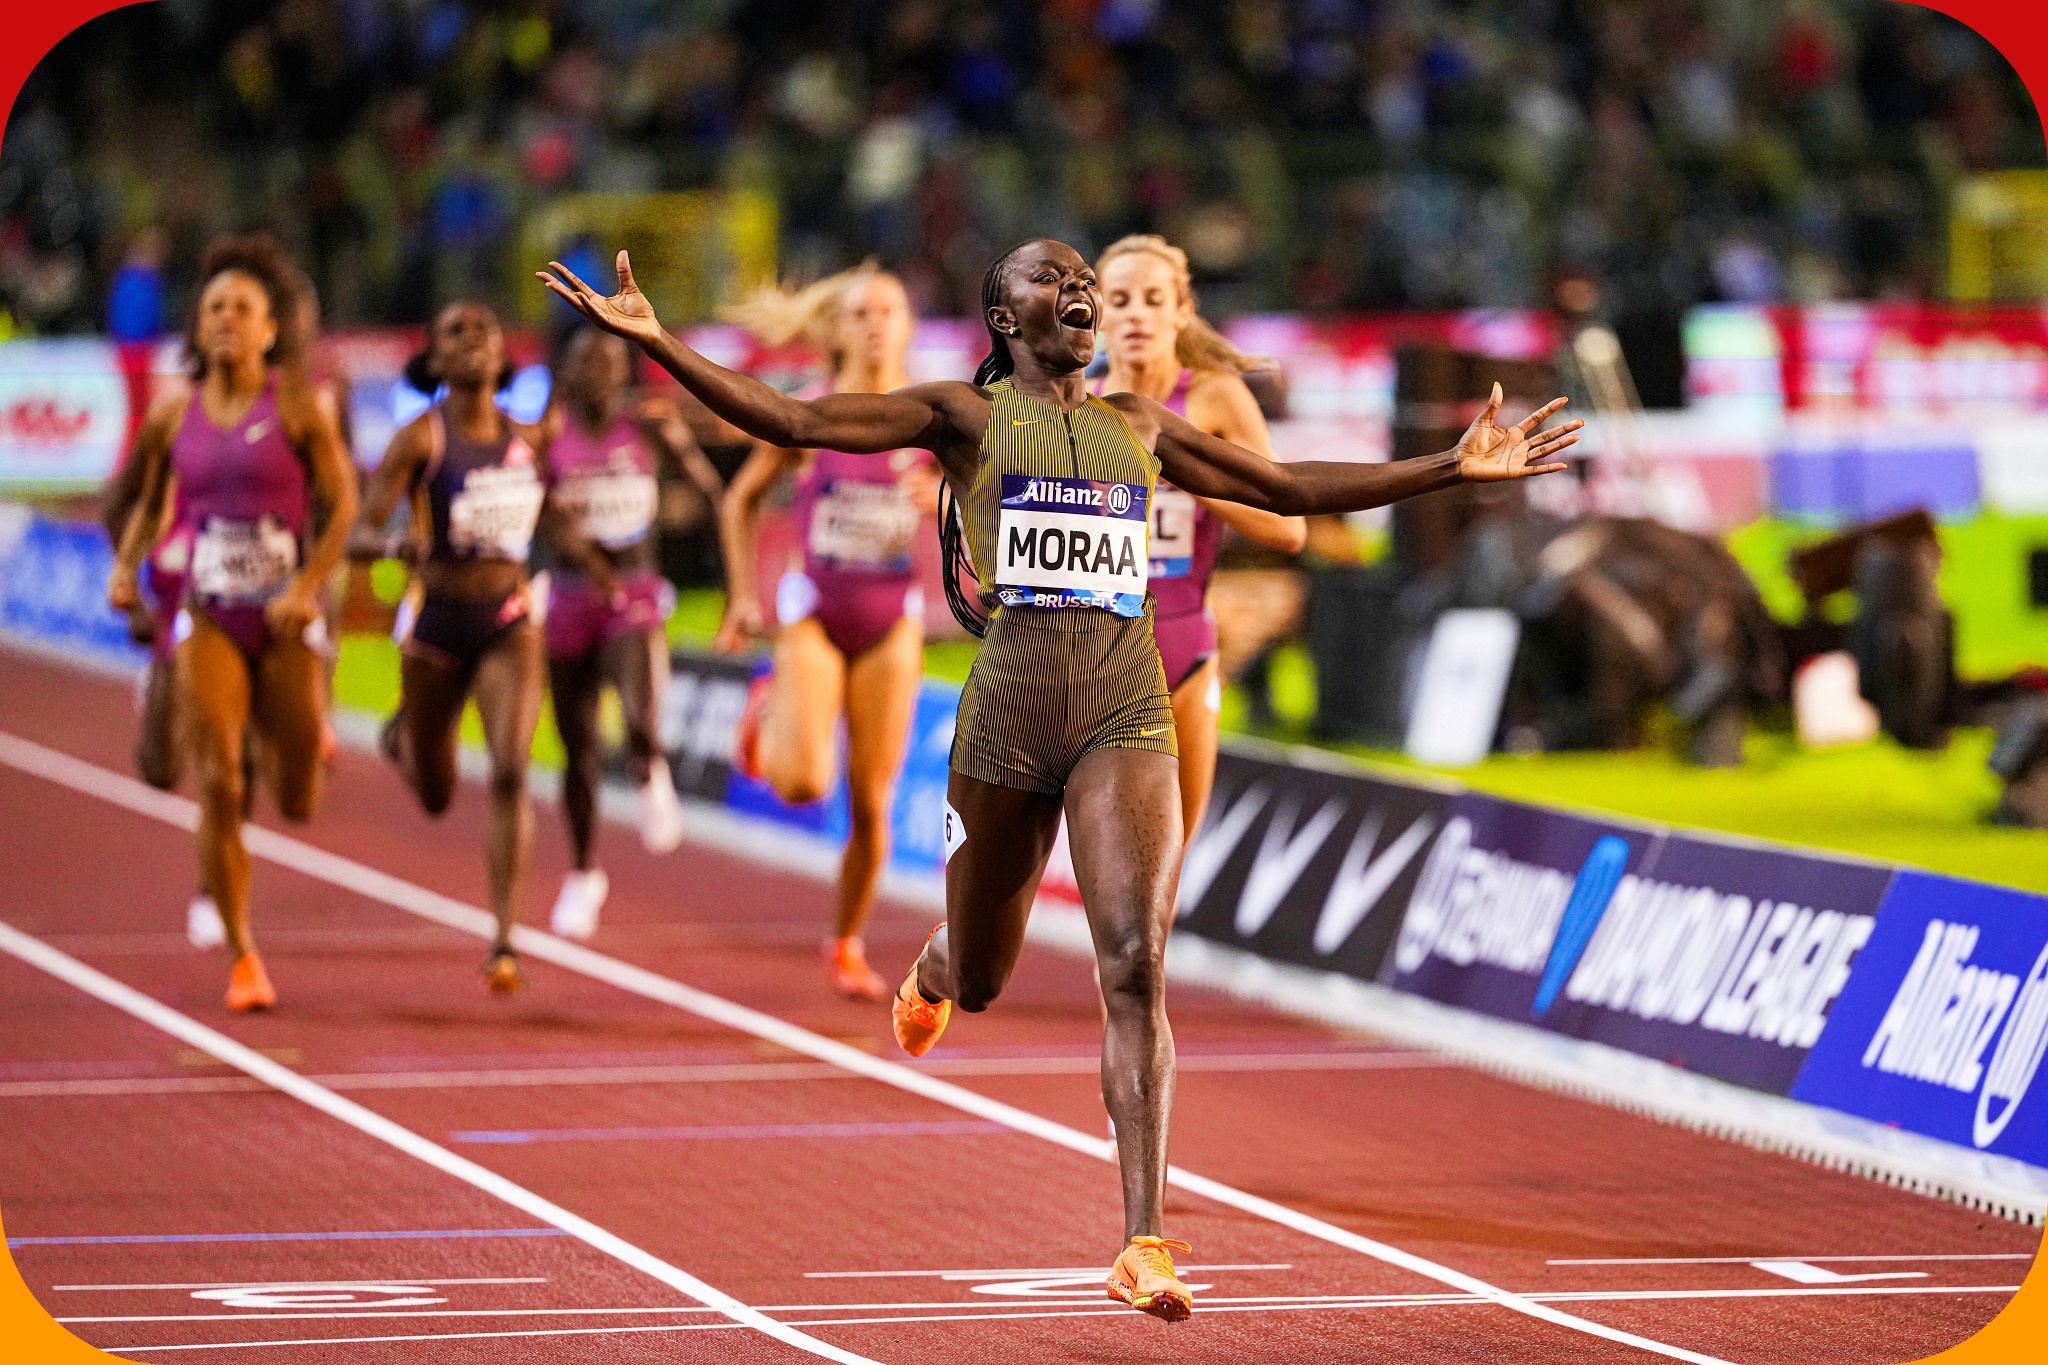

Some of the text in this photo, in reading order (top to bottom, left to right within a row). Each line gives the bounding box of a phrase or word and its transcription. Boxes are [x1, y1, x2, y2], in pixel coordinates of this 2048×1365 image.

[1022, 481, 1103, 506] Allianz
[1007, 526, 1139, 577] MORAA
[946, 812, 953, 843] 6
[1700, 898, 1876, 1048] LEAGUE
[1861, 918, 2020, 1094] Allianz
